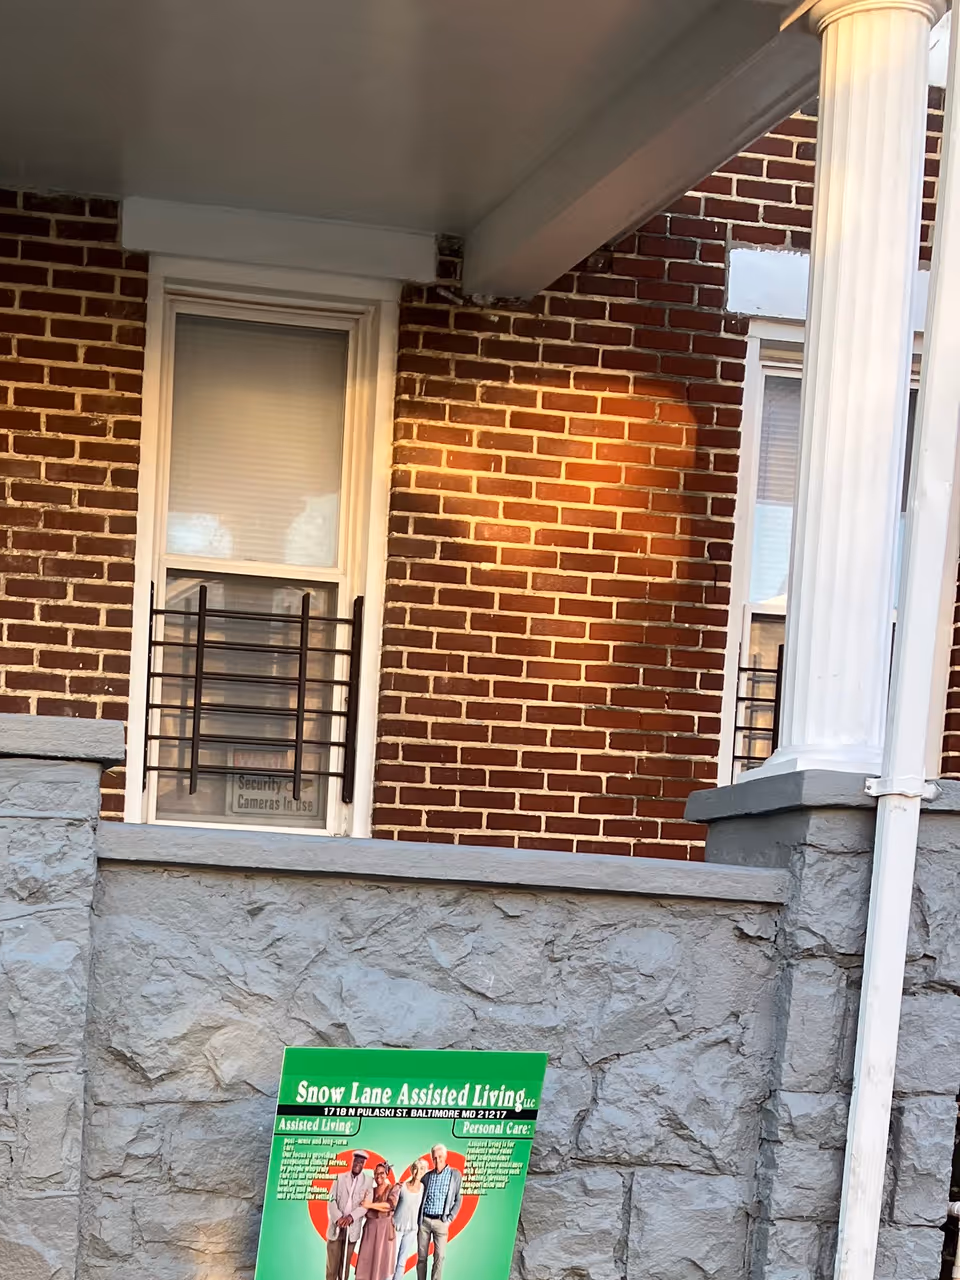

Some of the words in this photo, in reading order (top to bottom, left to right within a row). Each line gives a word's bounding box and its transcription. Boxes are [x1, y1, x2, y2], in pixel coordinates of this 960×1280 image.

[238, 775, 282, 795] Security
[237, 794, 281, 811] Cameras
[296, 1080, 345, 1103] Snow
[350, 1082, 392, 1104] Lane
[397, 1083, 470, 1106] Assisted
[472, 1084, 525, 1112] Living
[523, 1099, 536, 1108] LLC
[324, 1107, 346, 1116] 1718
[348, 1108, 356, 1116] N
[356, 1108, 394, 1117] PULASKI
[396, 1109, 409, 1117] ST.
[411, 1109, 460, 1118] BALTIMORE
[461, 1110, 476, 1118] MD
[477, 1110, 507, 1119] 21217
[278, 1117, 319, 1131] Assisted
[321, 1118, 354, 1134] Living:
[463, 1121, 504, 1134] Personal
[506, 1122, 531, 1135] Care:
